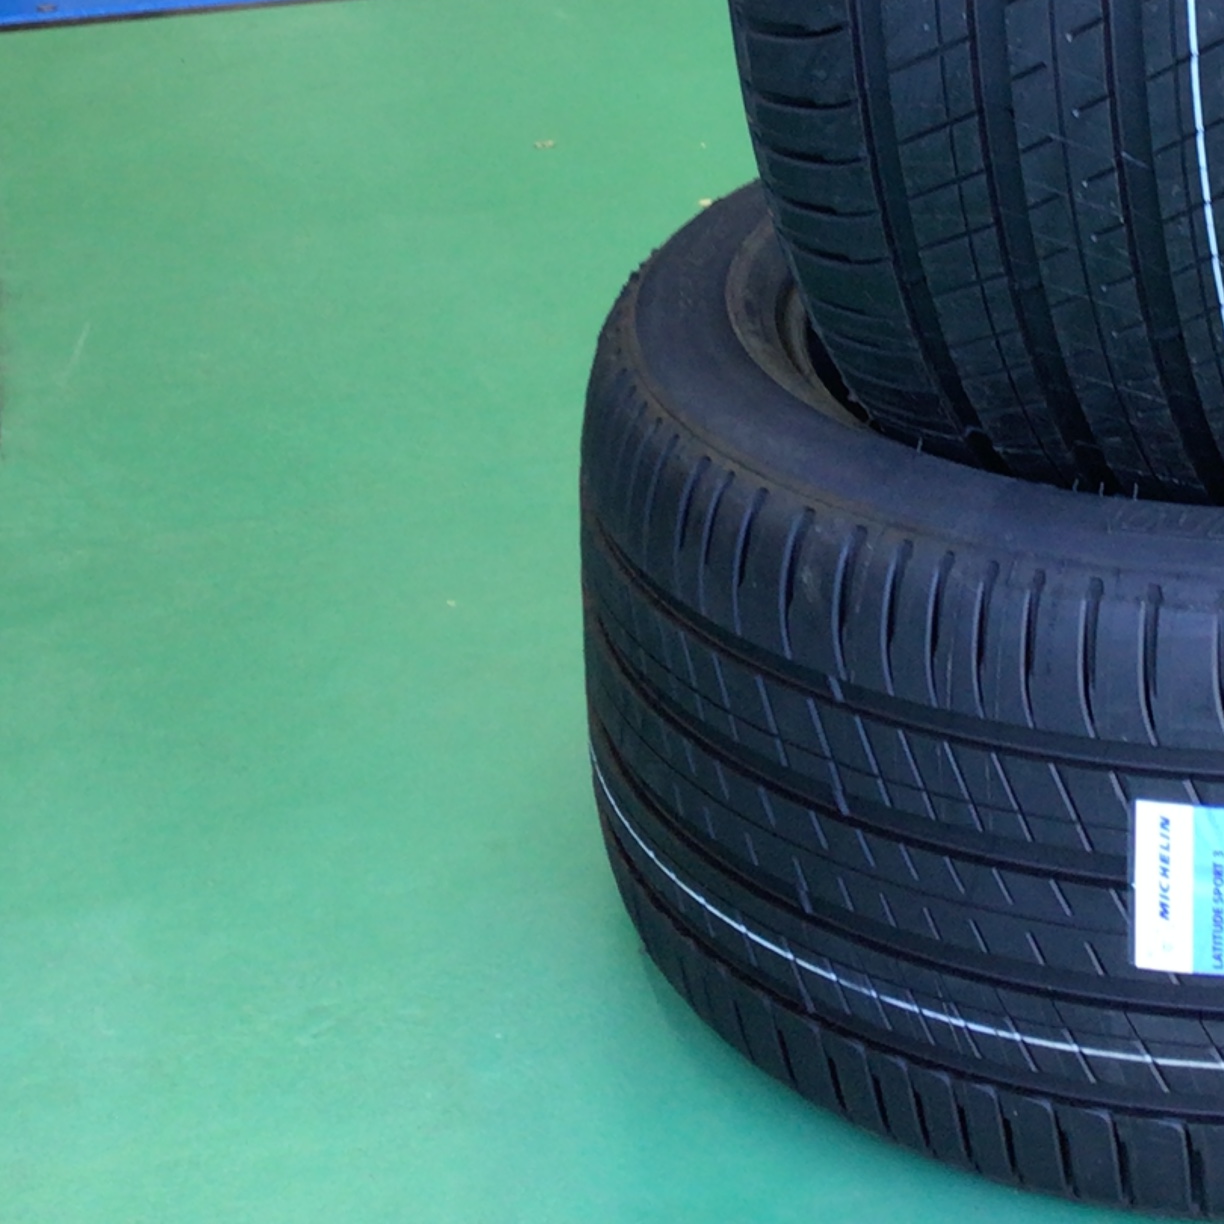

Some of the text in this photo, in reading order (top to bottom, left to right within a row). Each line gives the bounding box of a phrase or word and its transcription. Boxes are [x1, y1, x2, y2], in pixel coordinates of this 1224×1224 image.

[1159, 816, 1171, 920] MICHELIN
[1212, 863, 1224, 905] SPORT
[1212, 908, 1224, 970] LATITUDE
